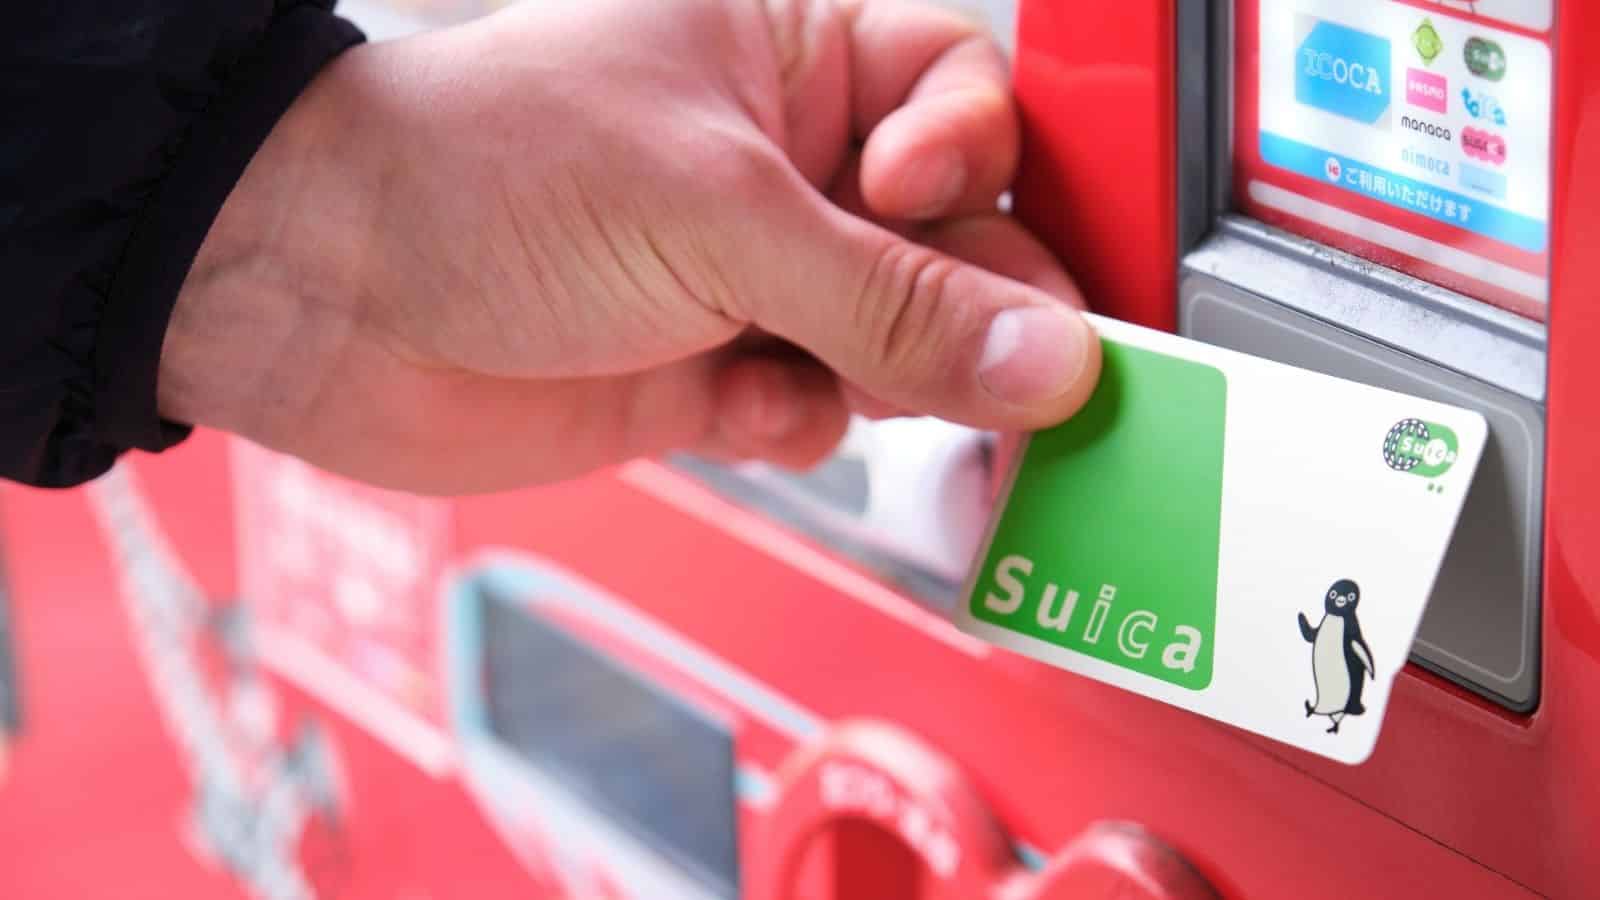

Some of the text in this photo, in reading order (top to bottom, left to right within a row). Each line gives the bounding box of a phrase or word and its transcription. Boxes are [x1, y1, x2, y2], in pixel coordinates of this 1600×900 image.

[1303, 47, 1382, 95] ICOCA
[1401, 115, 1452, 141] manaca
[984, 554, 1202, 673] Suica
